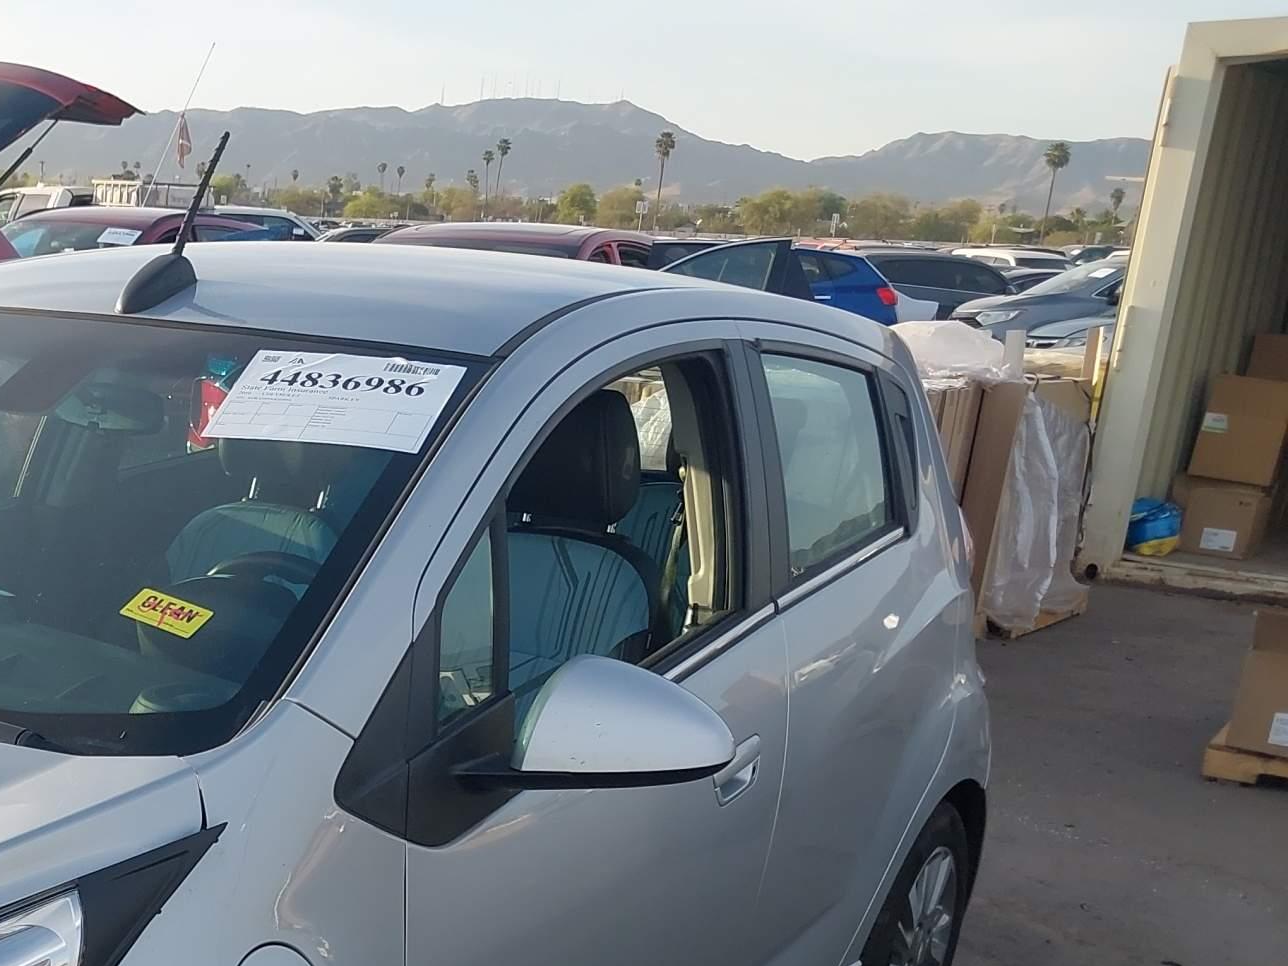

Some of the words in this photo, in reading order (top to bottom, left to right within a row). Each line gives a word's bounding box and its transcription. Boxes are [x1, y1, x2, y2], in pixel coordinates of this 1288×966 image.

[260, 369, 430, 397] 44836986
[287, 386, 329, 395] Insurance
[141, 595, 199, 623] CLEAN
